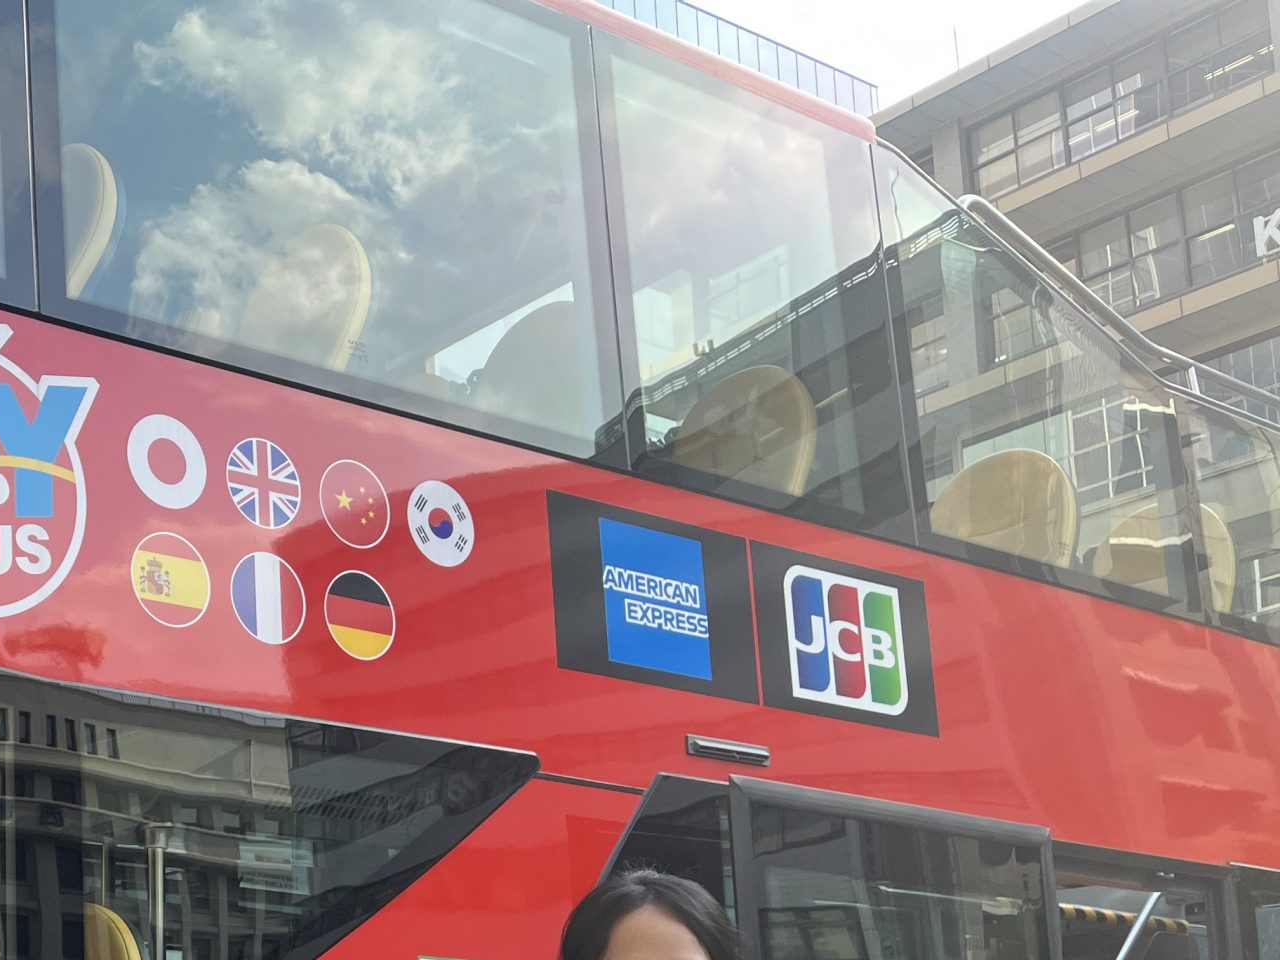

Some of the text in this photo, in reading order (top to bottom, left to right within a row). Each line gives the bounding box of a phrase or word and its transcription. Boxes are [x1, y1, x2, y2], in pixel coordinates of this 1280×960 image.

[603, 565, 699, 608] AMERICAN
[625, 599, 709, 638] EXPRESS
[793, 614, 897, 669] JCB
